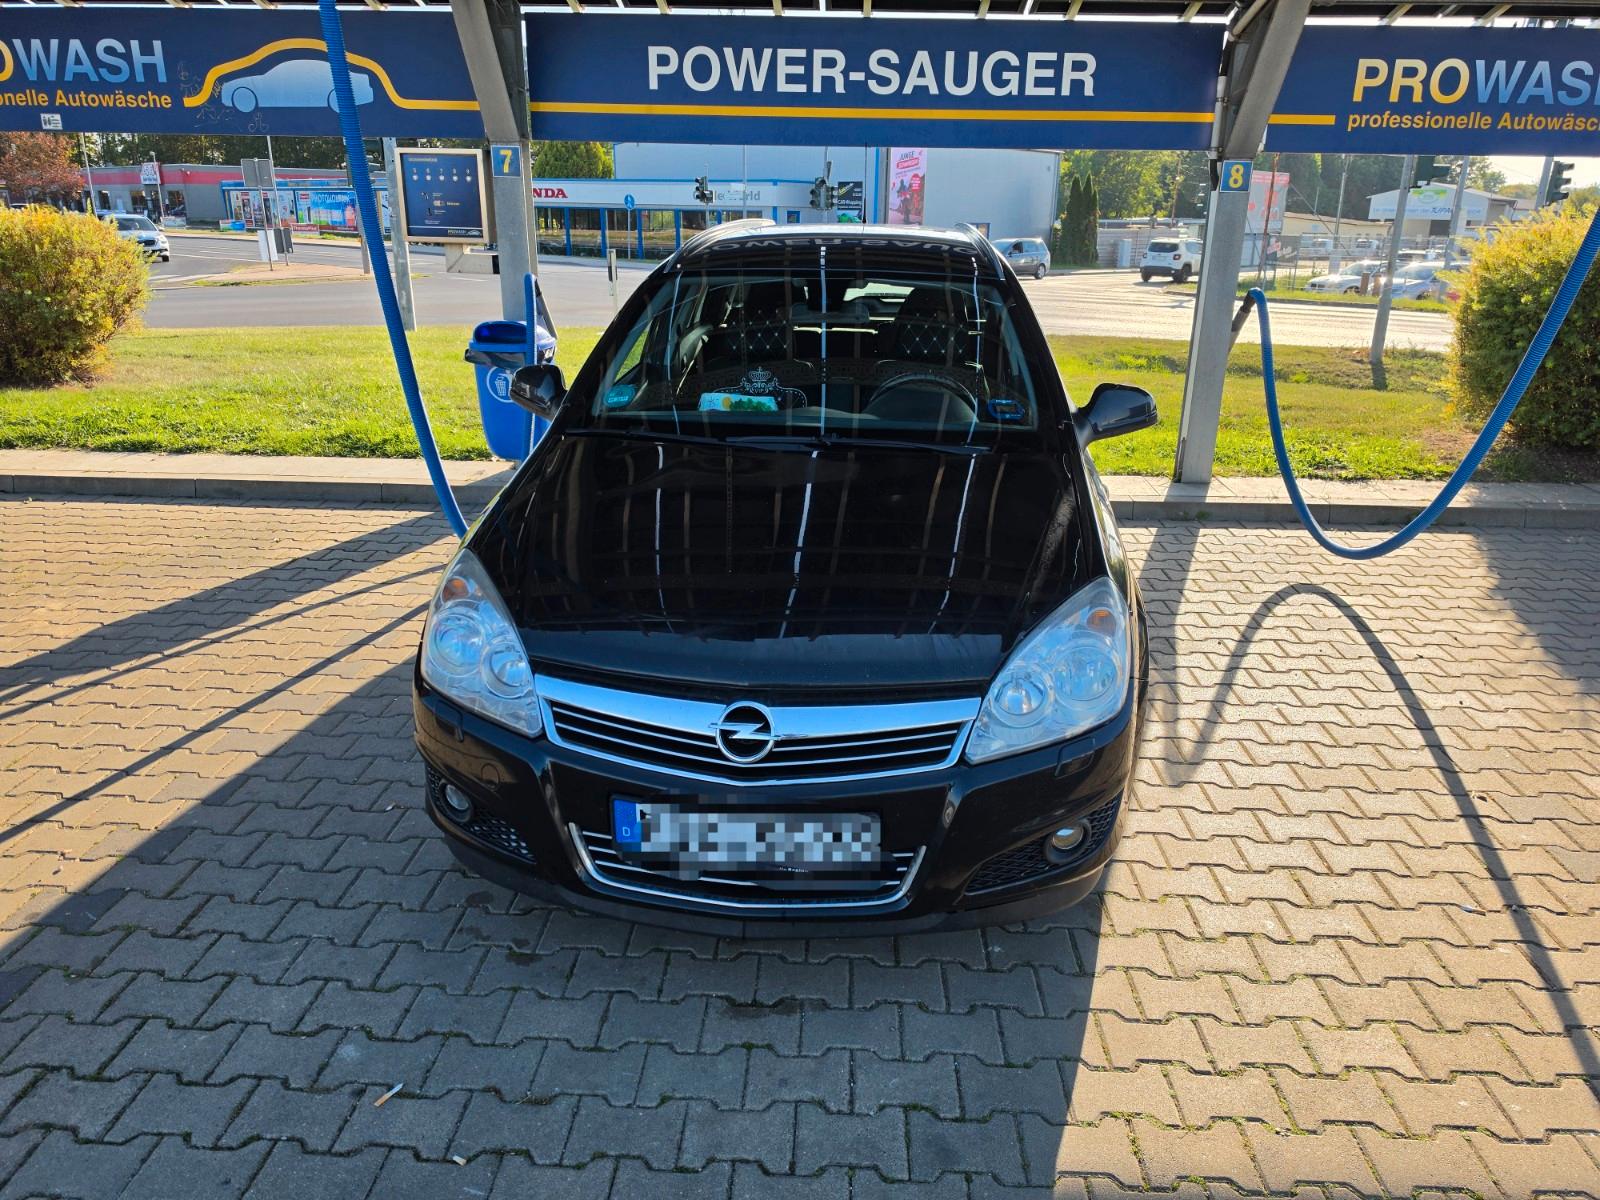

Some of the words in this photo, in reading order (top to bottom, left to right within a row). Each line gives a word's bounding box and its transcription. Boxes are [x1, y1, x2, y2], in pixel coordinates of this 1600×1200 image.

[648, 45, 1097, 97] POWER-SAUGER
[1352, 58, 1600, 106] PROWAS
[55, 90, 172, 108] Autowäsche
[1347, 111, 1492, 132] professionelle
[1497, 112, 1600, 131] Autowäsc
[500, 149, 512, 173] 7
[1229, 164, 1244, 188] 8
[532, 188, 568, 198] NDA
[622, 826, 631, 837] D
